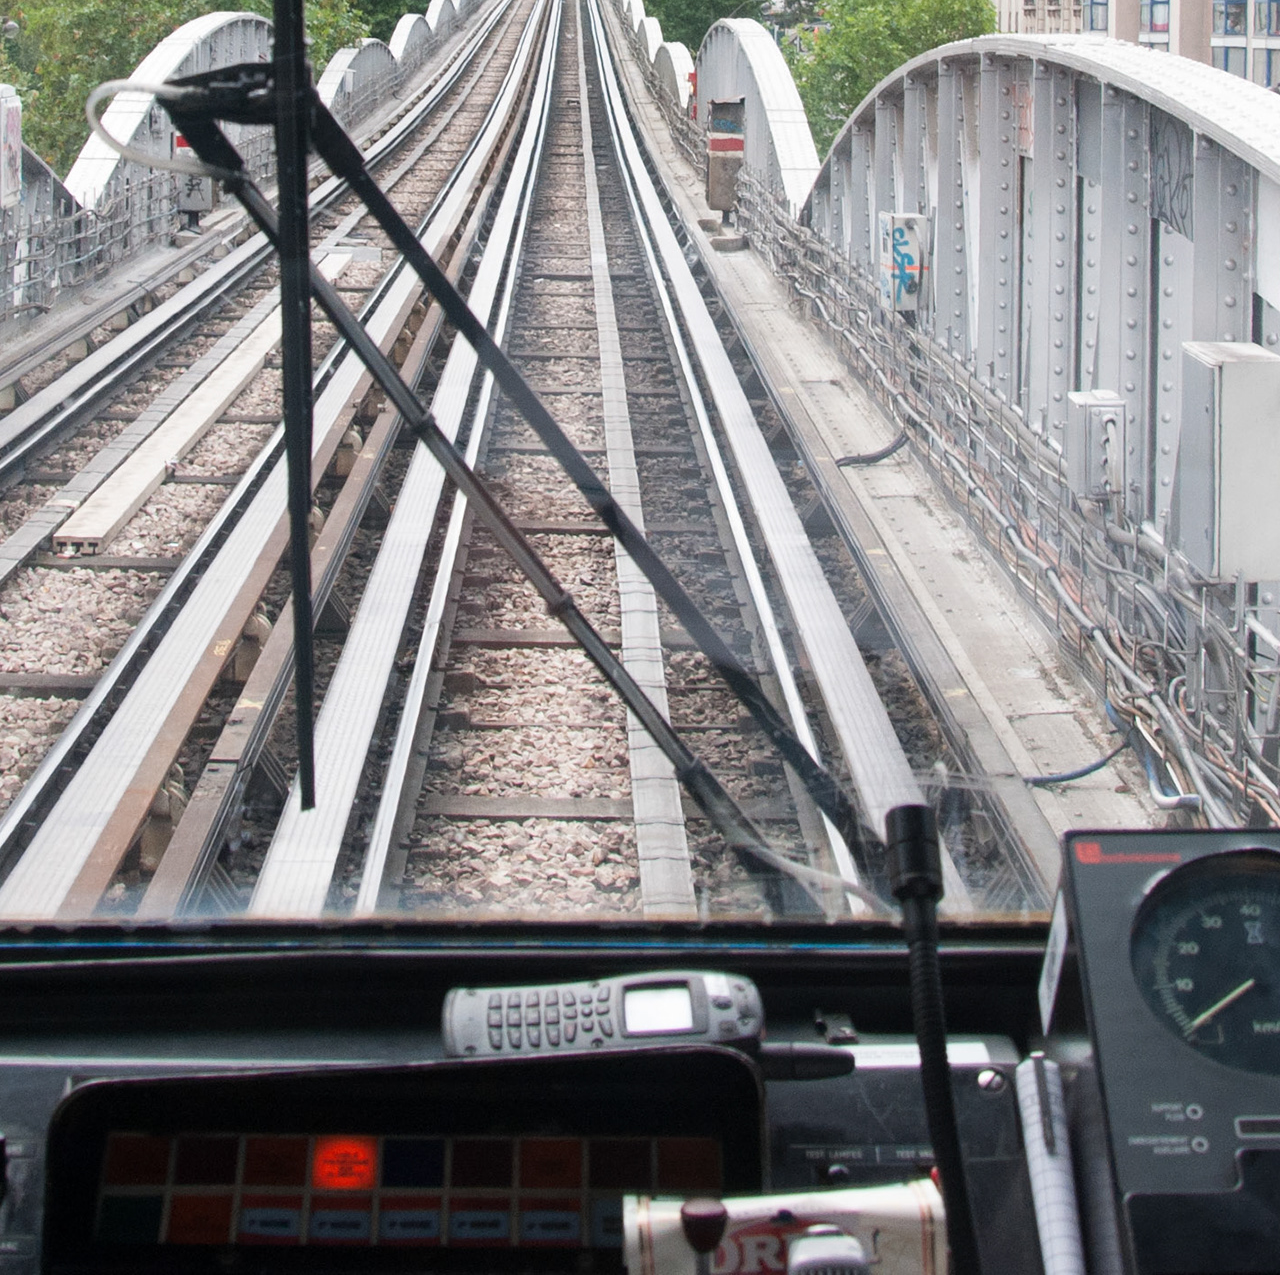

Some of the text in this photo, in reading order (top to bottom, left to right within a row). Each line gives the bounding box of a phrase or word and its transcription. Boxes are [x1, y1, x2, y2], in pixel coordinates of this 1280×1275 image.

[1239, 904, 1261, 916] 40
[1177, 941, 1200, 955] 20
[1175, 978, 1195, 992] 10
